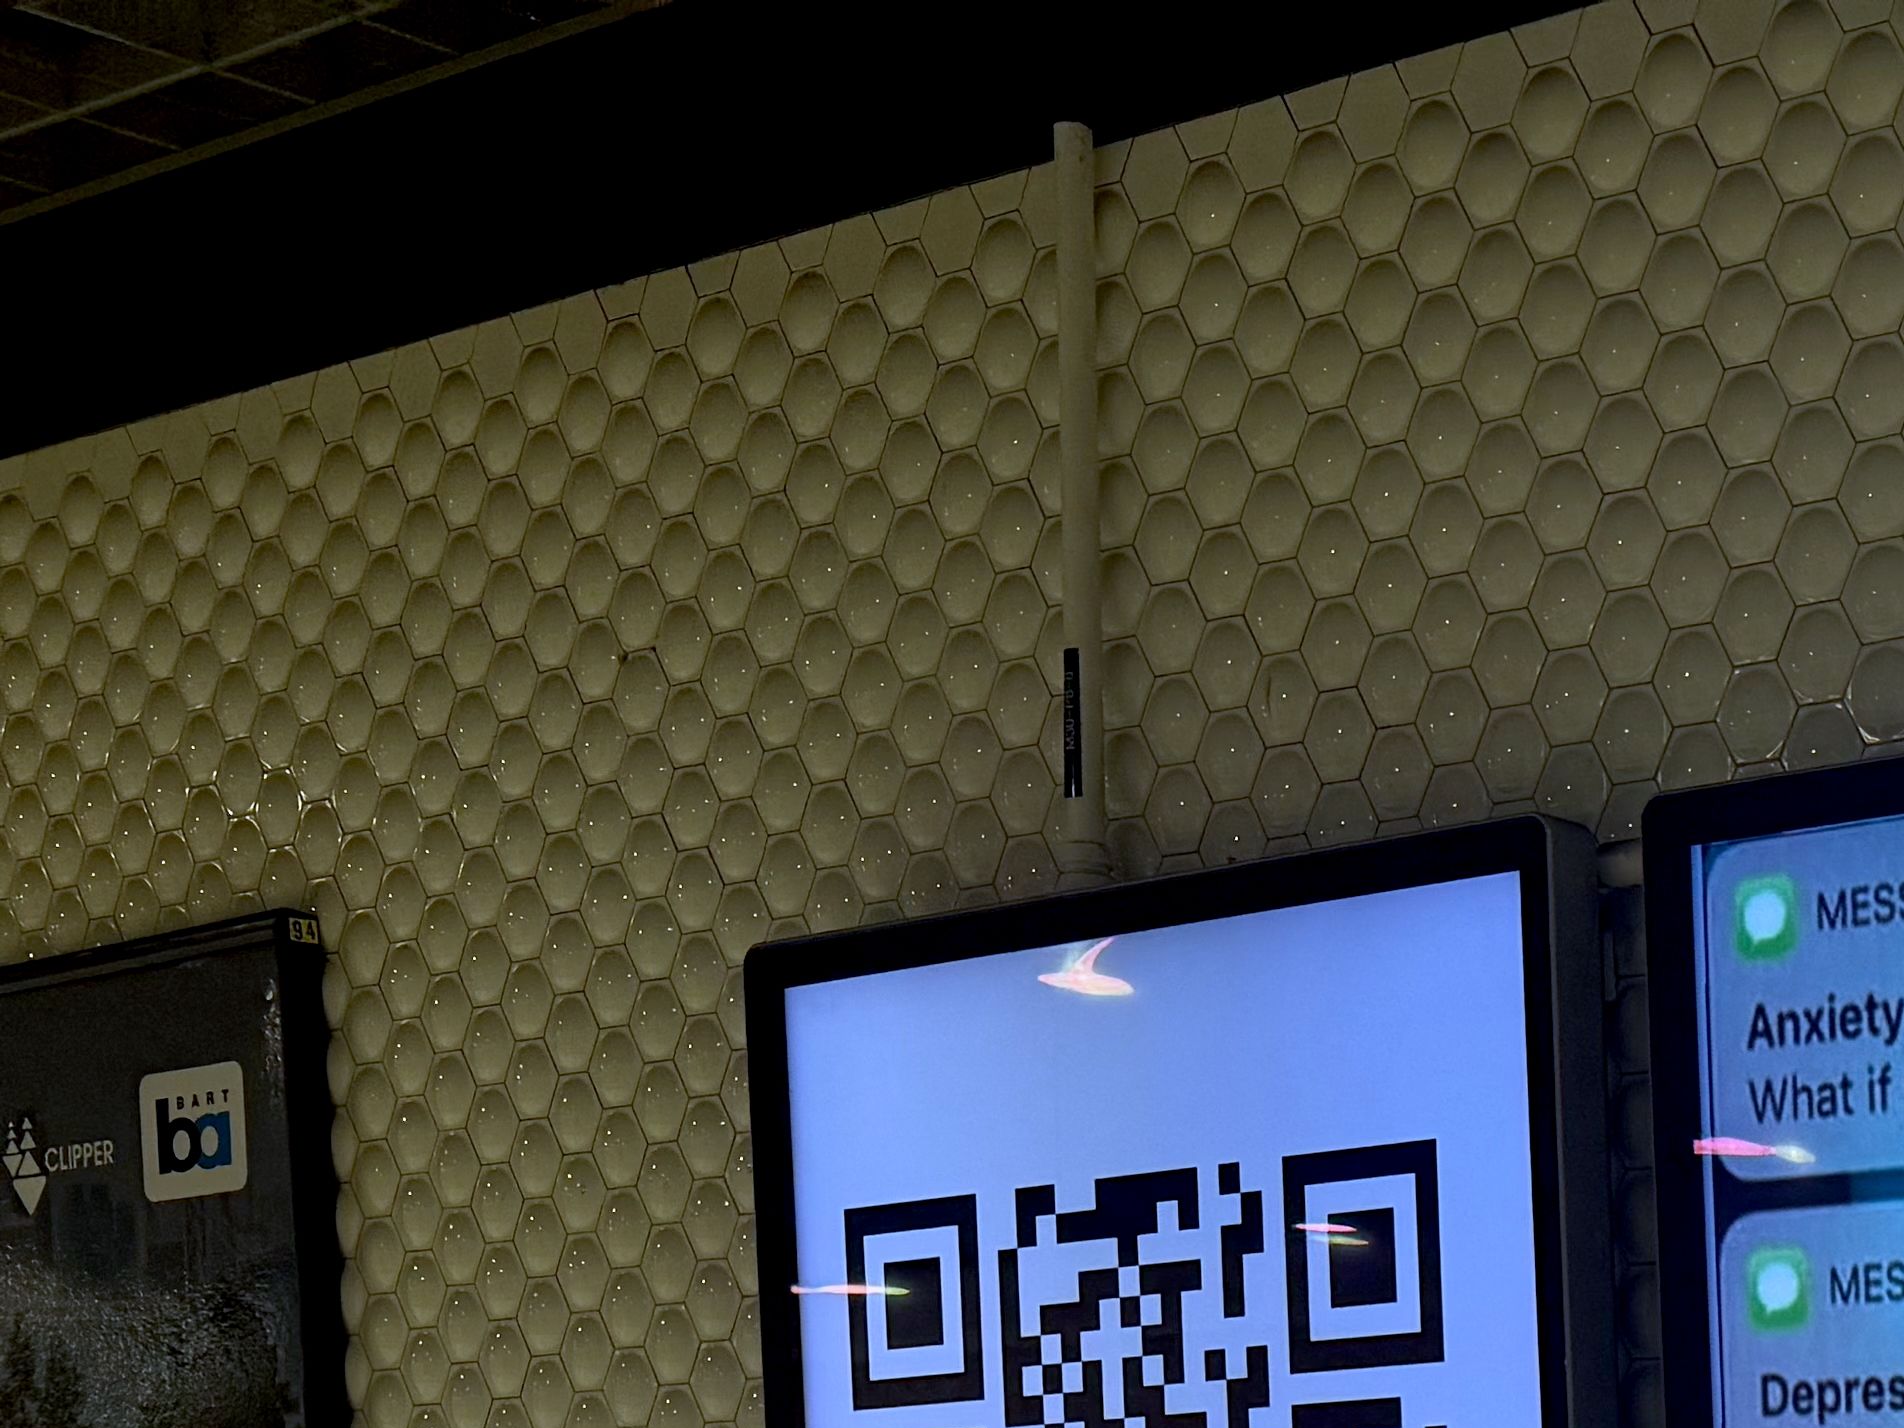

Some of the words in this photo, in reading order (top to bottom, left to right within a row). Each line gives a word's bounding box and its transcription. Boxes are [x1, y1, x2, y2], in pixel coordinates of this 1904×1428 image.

[1748, 994, 1904, 1049] Anxiety
[177, 1089, 230, 1110] BART
[1749, 1075, 1853, 1123] What
[1866, 1062, 1896, 1116] if
[44, 1139, 115, 1172] CLIPPER
